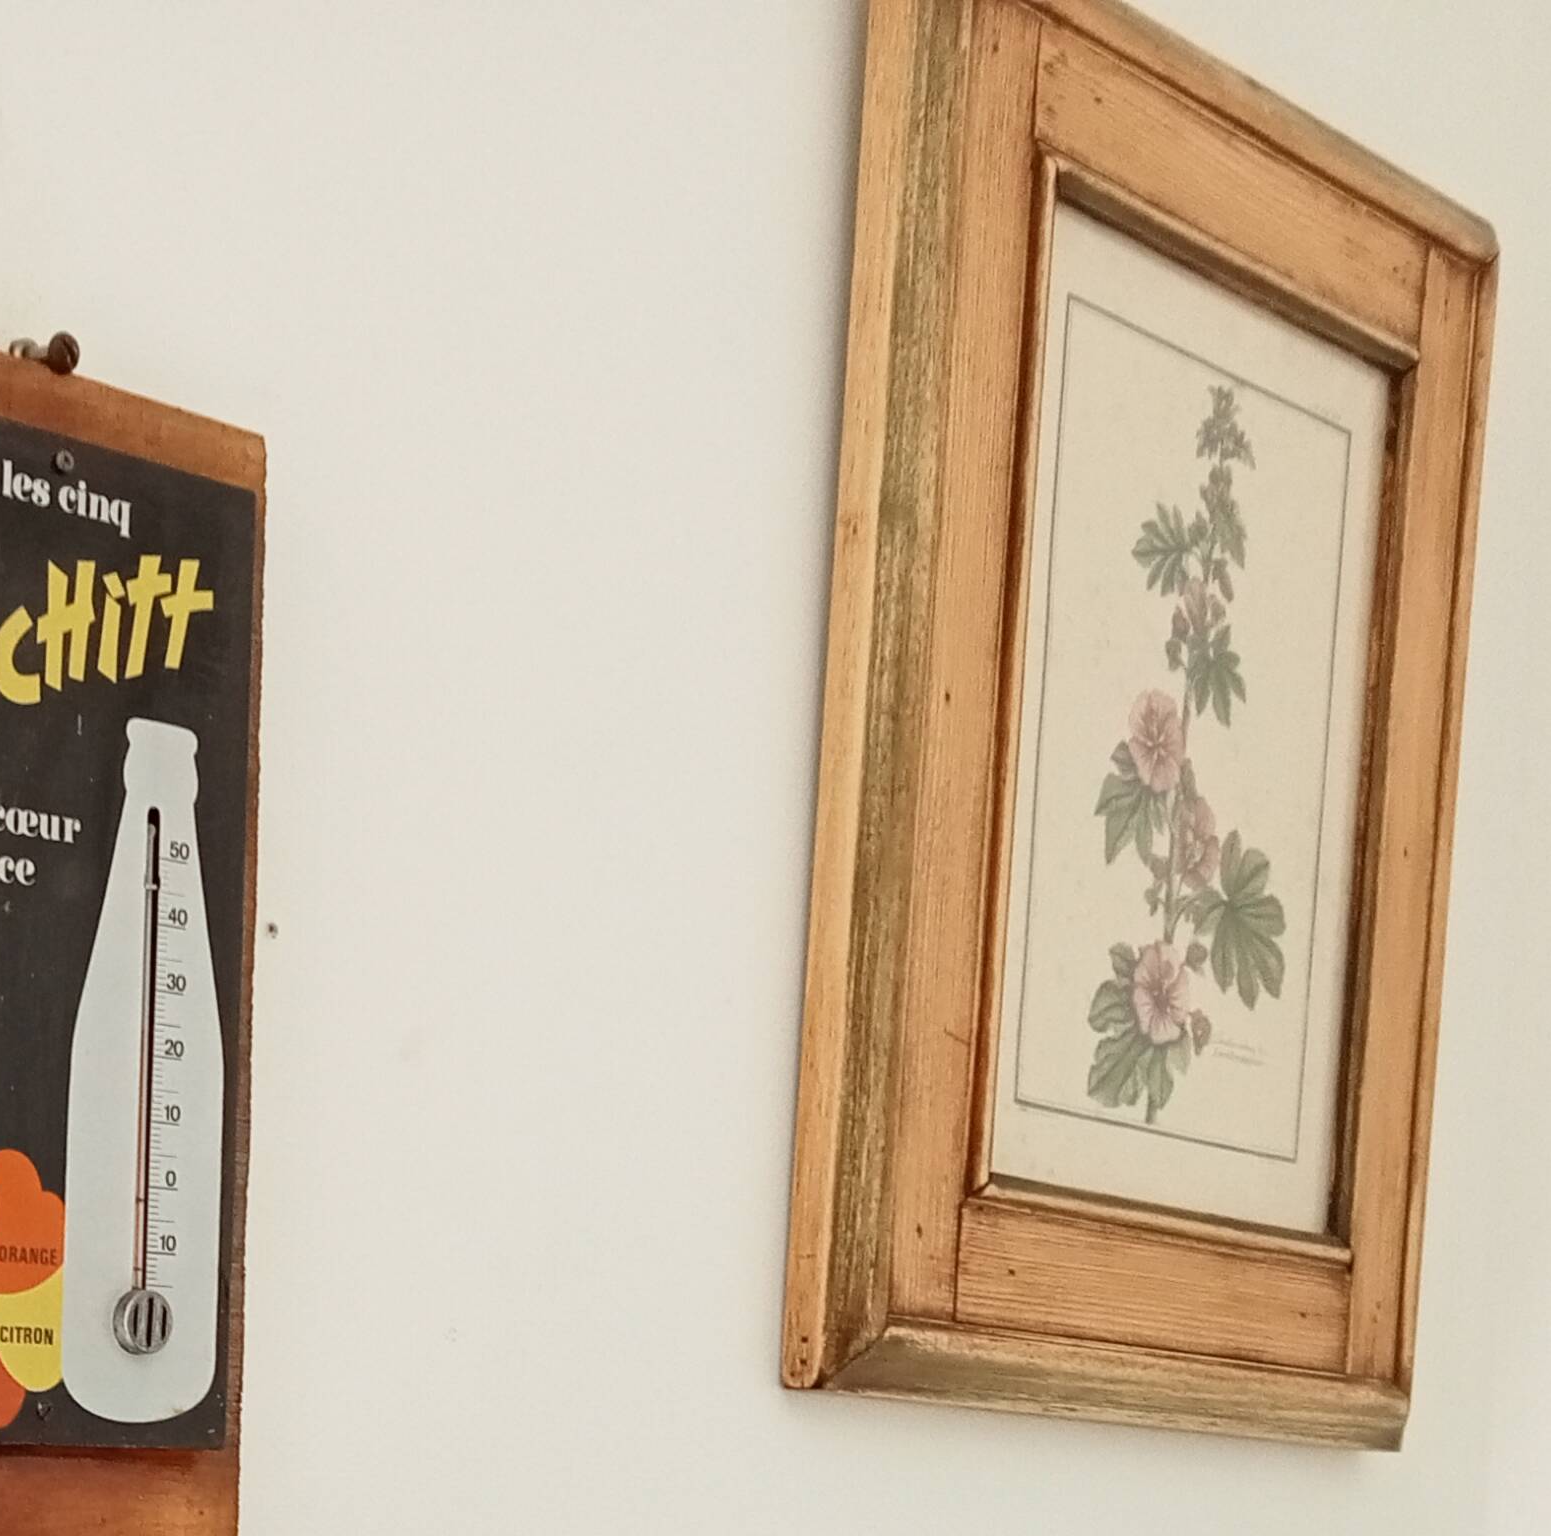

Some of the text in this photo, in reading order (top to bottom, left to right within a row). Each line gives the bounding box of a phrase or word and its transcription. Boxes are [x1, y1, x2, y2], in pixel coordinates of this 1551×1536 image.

[1, 459, 51, 507] les
[57, 478, 133, 539] cinq
[169, 841, 190, 860] 50
[167, 908, 188, 926] 40
[165, 974, 186, 992] 30
[163, 1040, 184, 1058] 20
[164, 1105, 181, 1122] 10
[165, 1170, 177, 1187] 0
[159, 1235, 177, 1251] 10
[0, 1326, 55, 1346] CITRON
